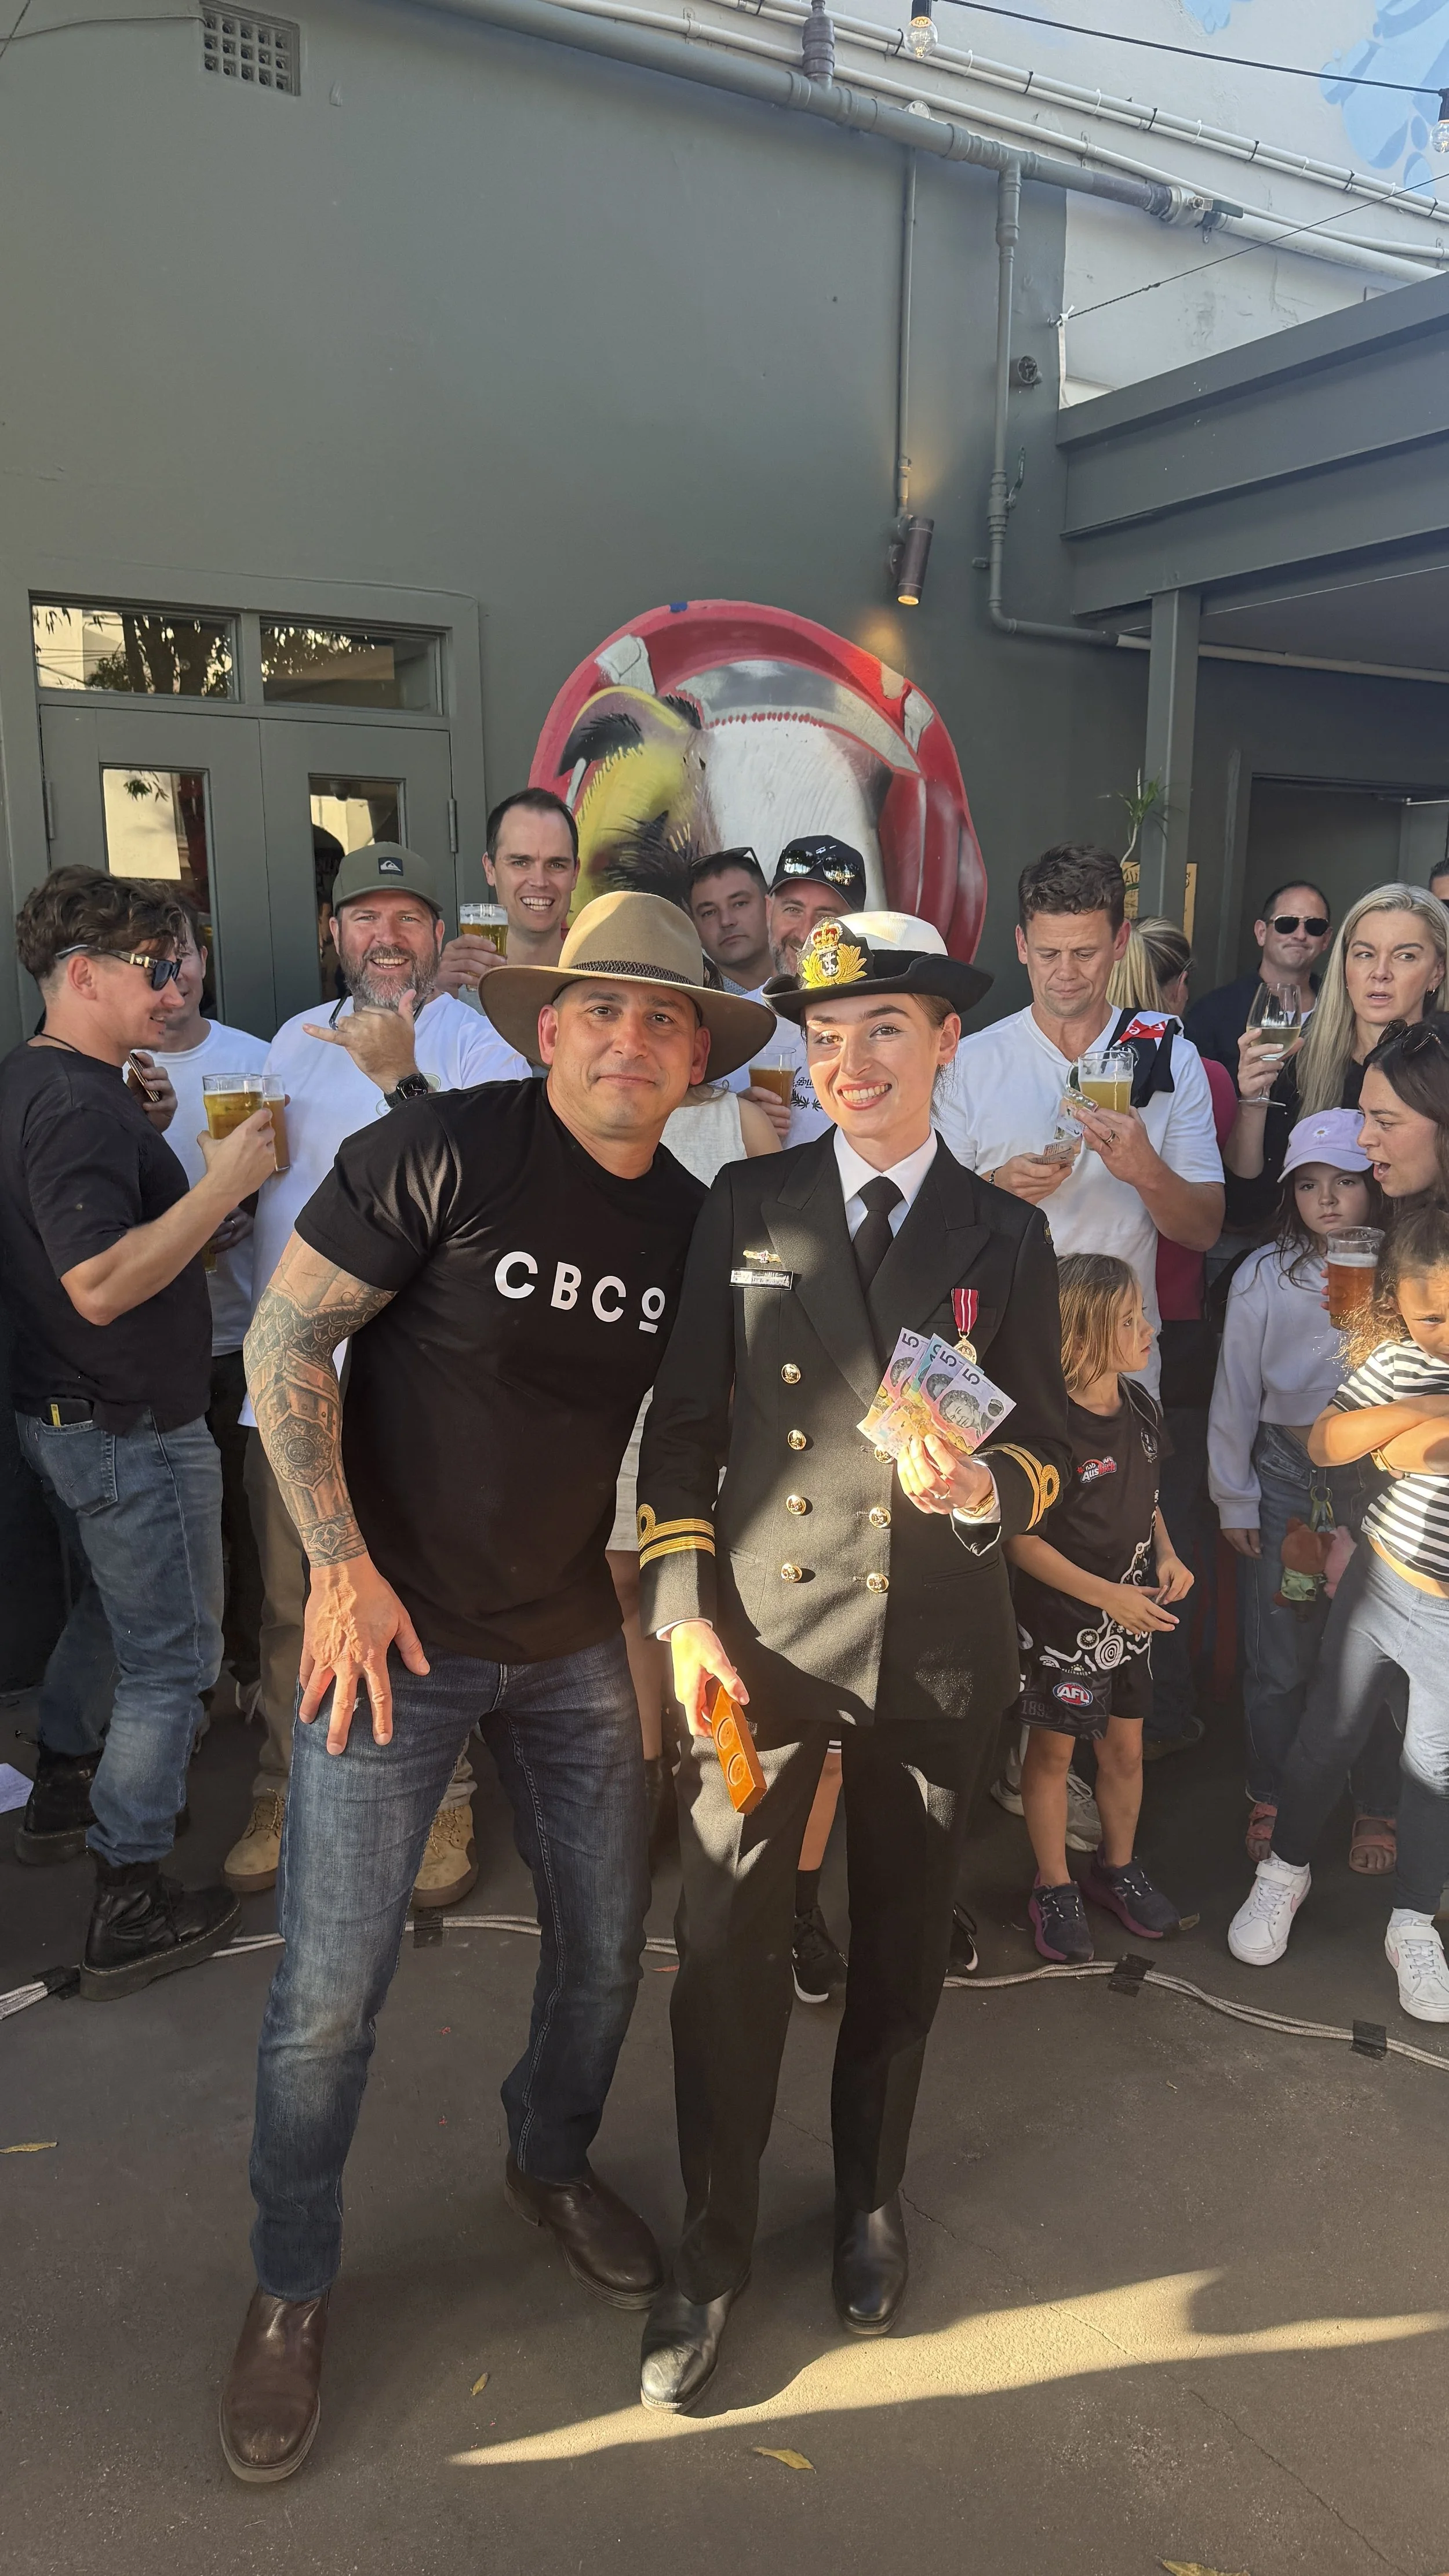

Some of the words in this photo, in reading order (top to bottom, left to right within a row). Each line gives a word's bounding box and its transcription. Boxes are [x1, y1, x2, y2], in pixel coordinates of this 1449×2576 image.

[901, 1333, 919, 1348] 5
[930, 1344, 942, 1362] 10
[939, 1351, 957, 1367] 5
[962, 1368, 980, 1385] 5
[1085, 1462, 1096, 1471] nab
[1057, 1687, 1090, 1703] AFL
